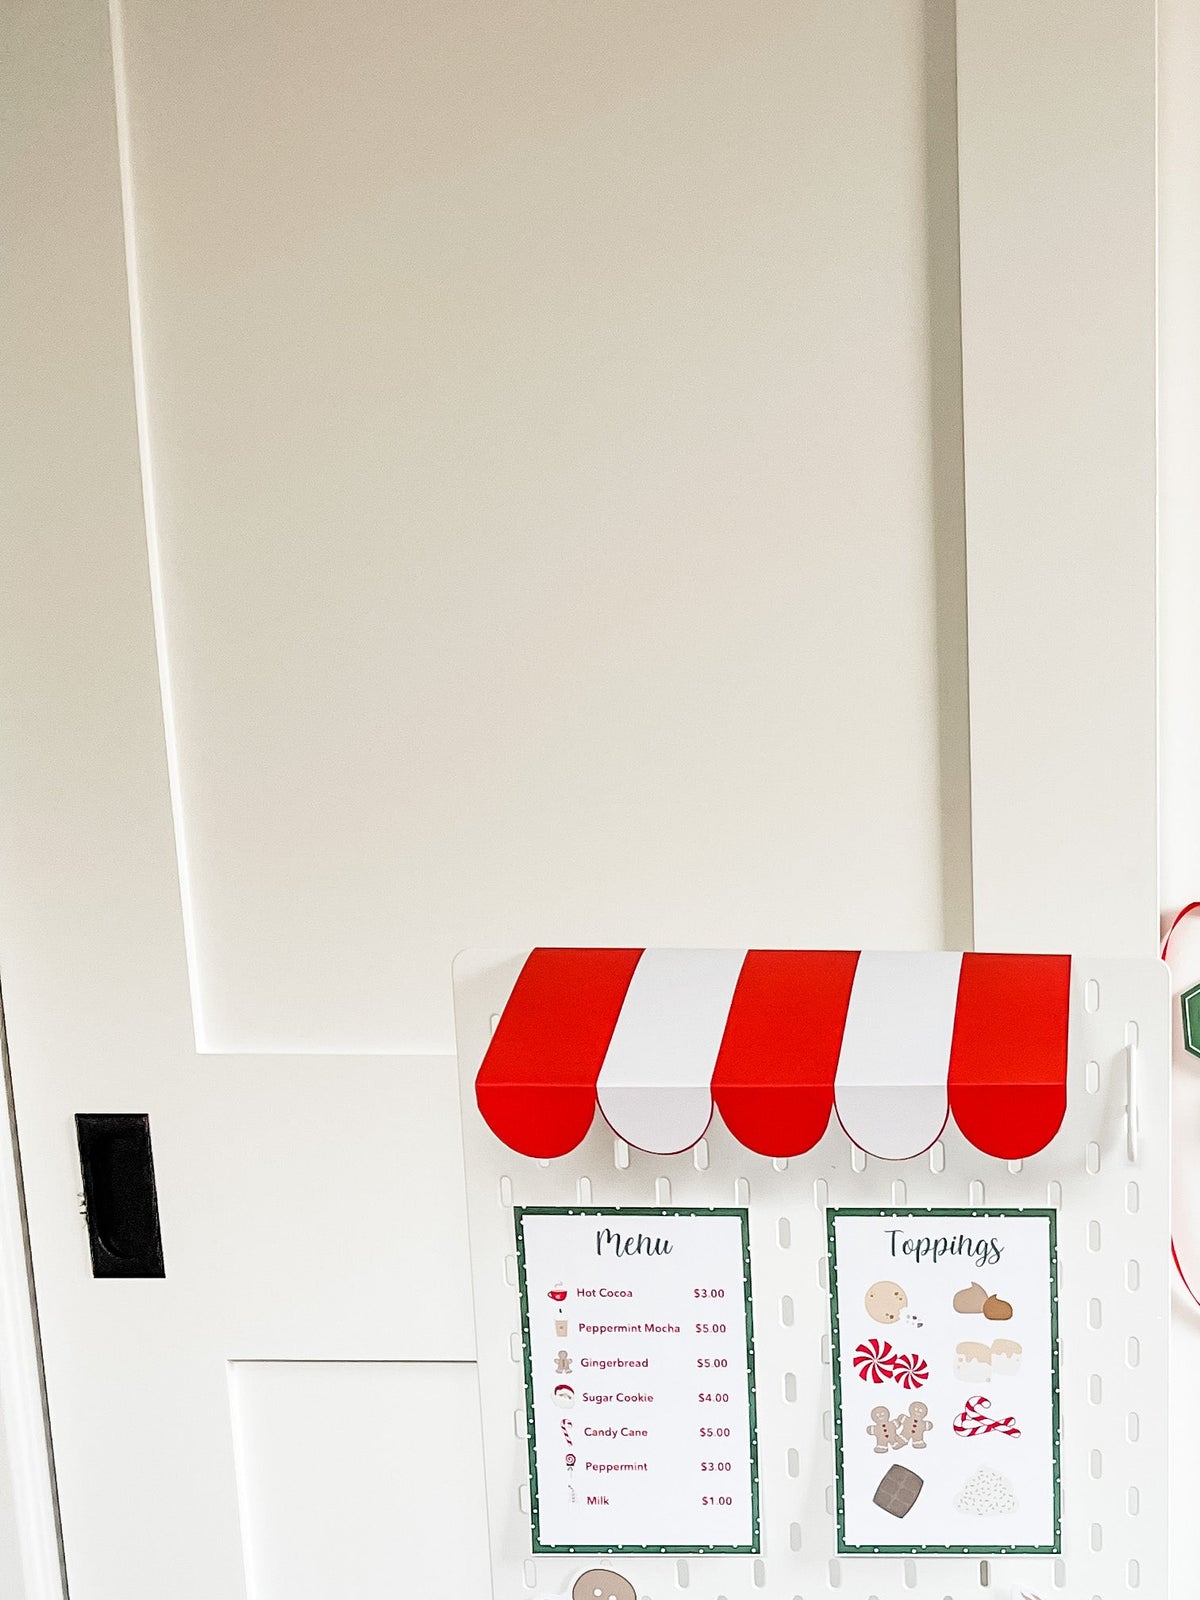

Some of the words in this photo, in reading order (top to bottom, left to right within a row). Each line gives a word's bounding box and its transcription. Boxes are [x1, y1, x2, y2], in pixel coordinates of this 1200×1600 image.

[597, 1228, 673, 1257] Menu
[884, 1230, 1004, 1267] Toppings
[577, 1288, 596, 1297] Hot
[599, 1288, 632, 1297] Cocoa
[694, 1289, 724, 1298] $3.00
[579, 1323, 641, 1334] Peppermint
[645, 1324, 680, 1332] Mocha
[696, 1324, 726, 1333] $5.00
[581, 1358, 648, 1369] Gingerbread
[697, 1359, 727, 1368] $5.00
[583, 1393, 613, 1404] Sugar
[616, 1393, 654, 1402] Cookie
[699, 1393, 728, 1402] $4.00
[584, 1427, 618, 1439] Candy
[621, 1428, 648, 1436] Cane
[700, 1428, 730, 1437] $5.00
[586, 1462, 647, 1473] Peppermint
[701, 1462, 731, 1471] $3.00
[587, 1496, 609, 1505] Milk
[702, 1496, 732, 1505] $1.00
